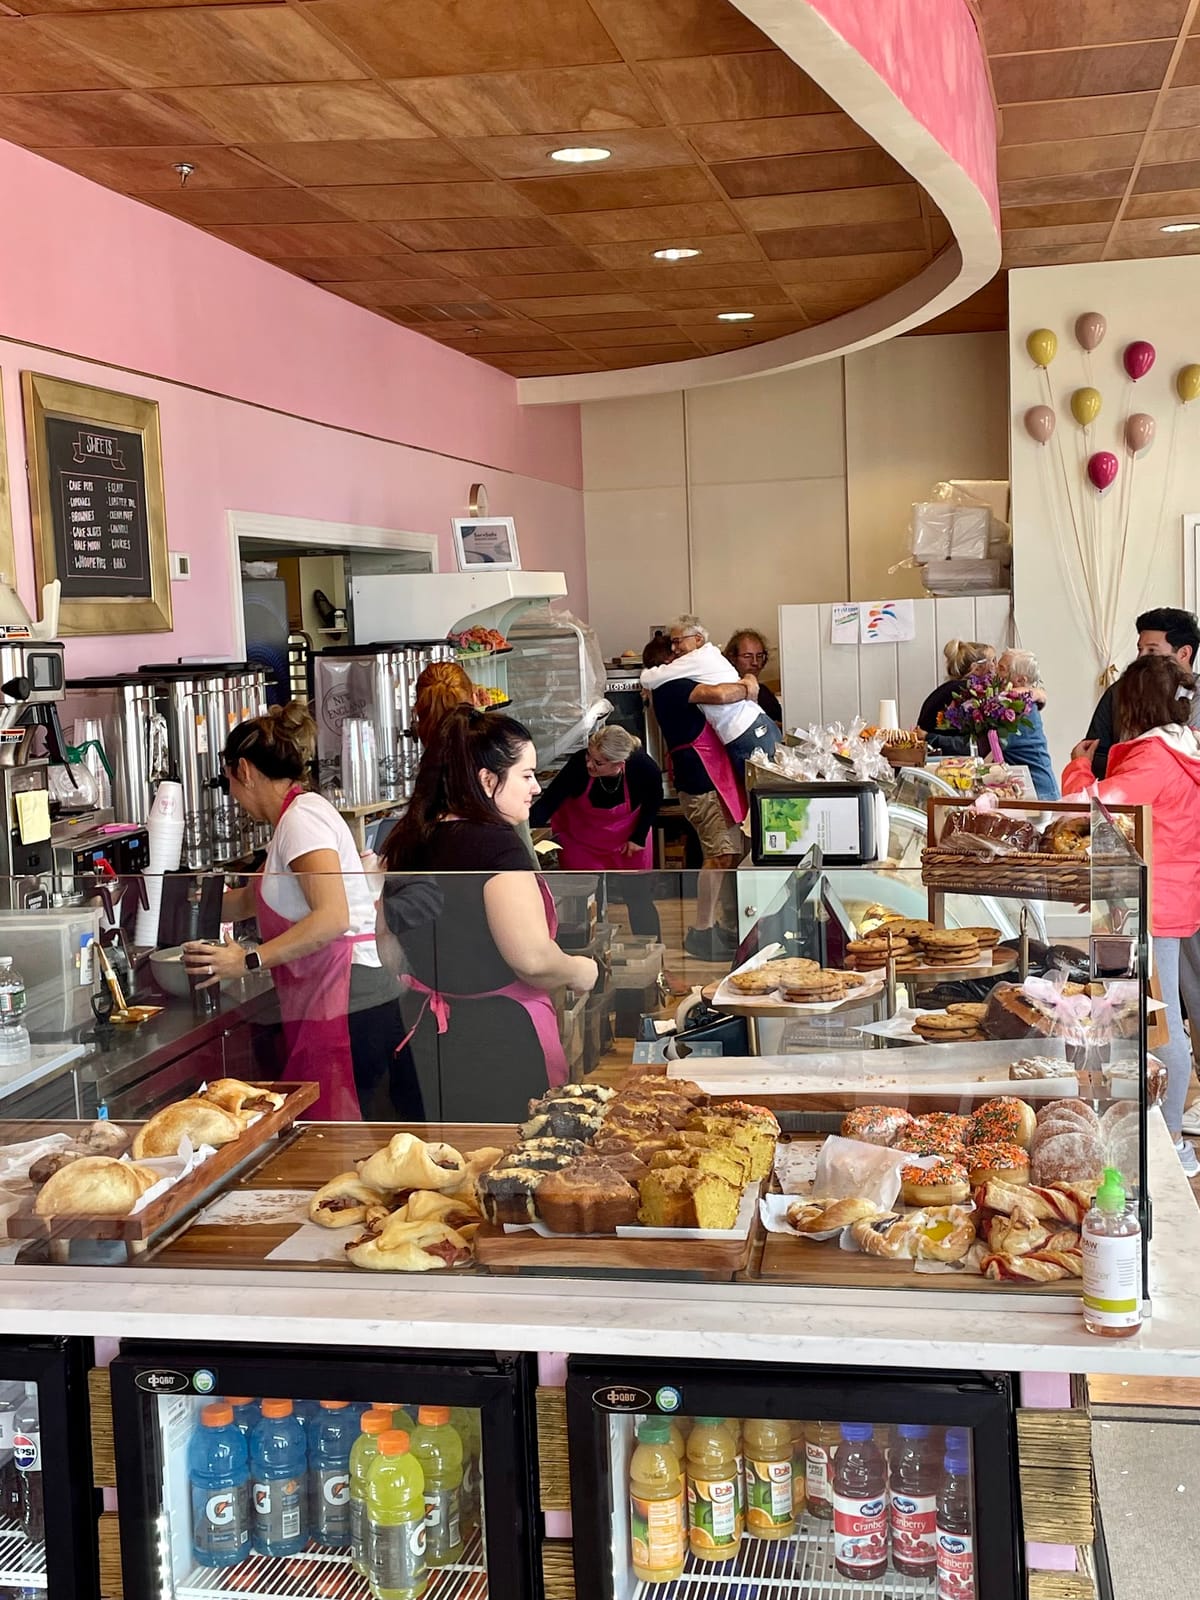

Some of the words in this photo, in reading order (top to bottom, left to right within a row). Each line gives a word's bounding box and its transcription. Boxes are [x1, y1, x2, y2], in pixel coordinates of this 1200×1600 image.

[86, 435, 113, 456] SWEETS
[16, 1448, 35, 1456] EPSI
[253, 1483, 271, 1515] G
[323, 1475, 350, 1506] G
[206, 1493, 233, 1525] G
[853, 1520, 885, 1532] Cranbe
[894, 1517, 926, 1530] ranberry
[940, 1556, 973, 1572] ranberry
